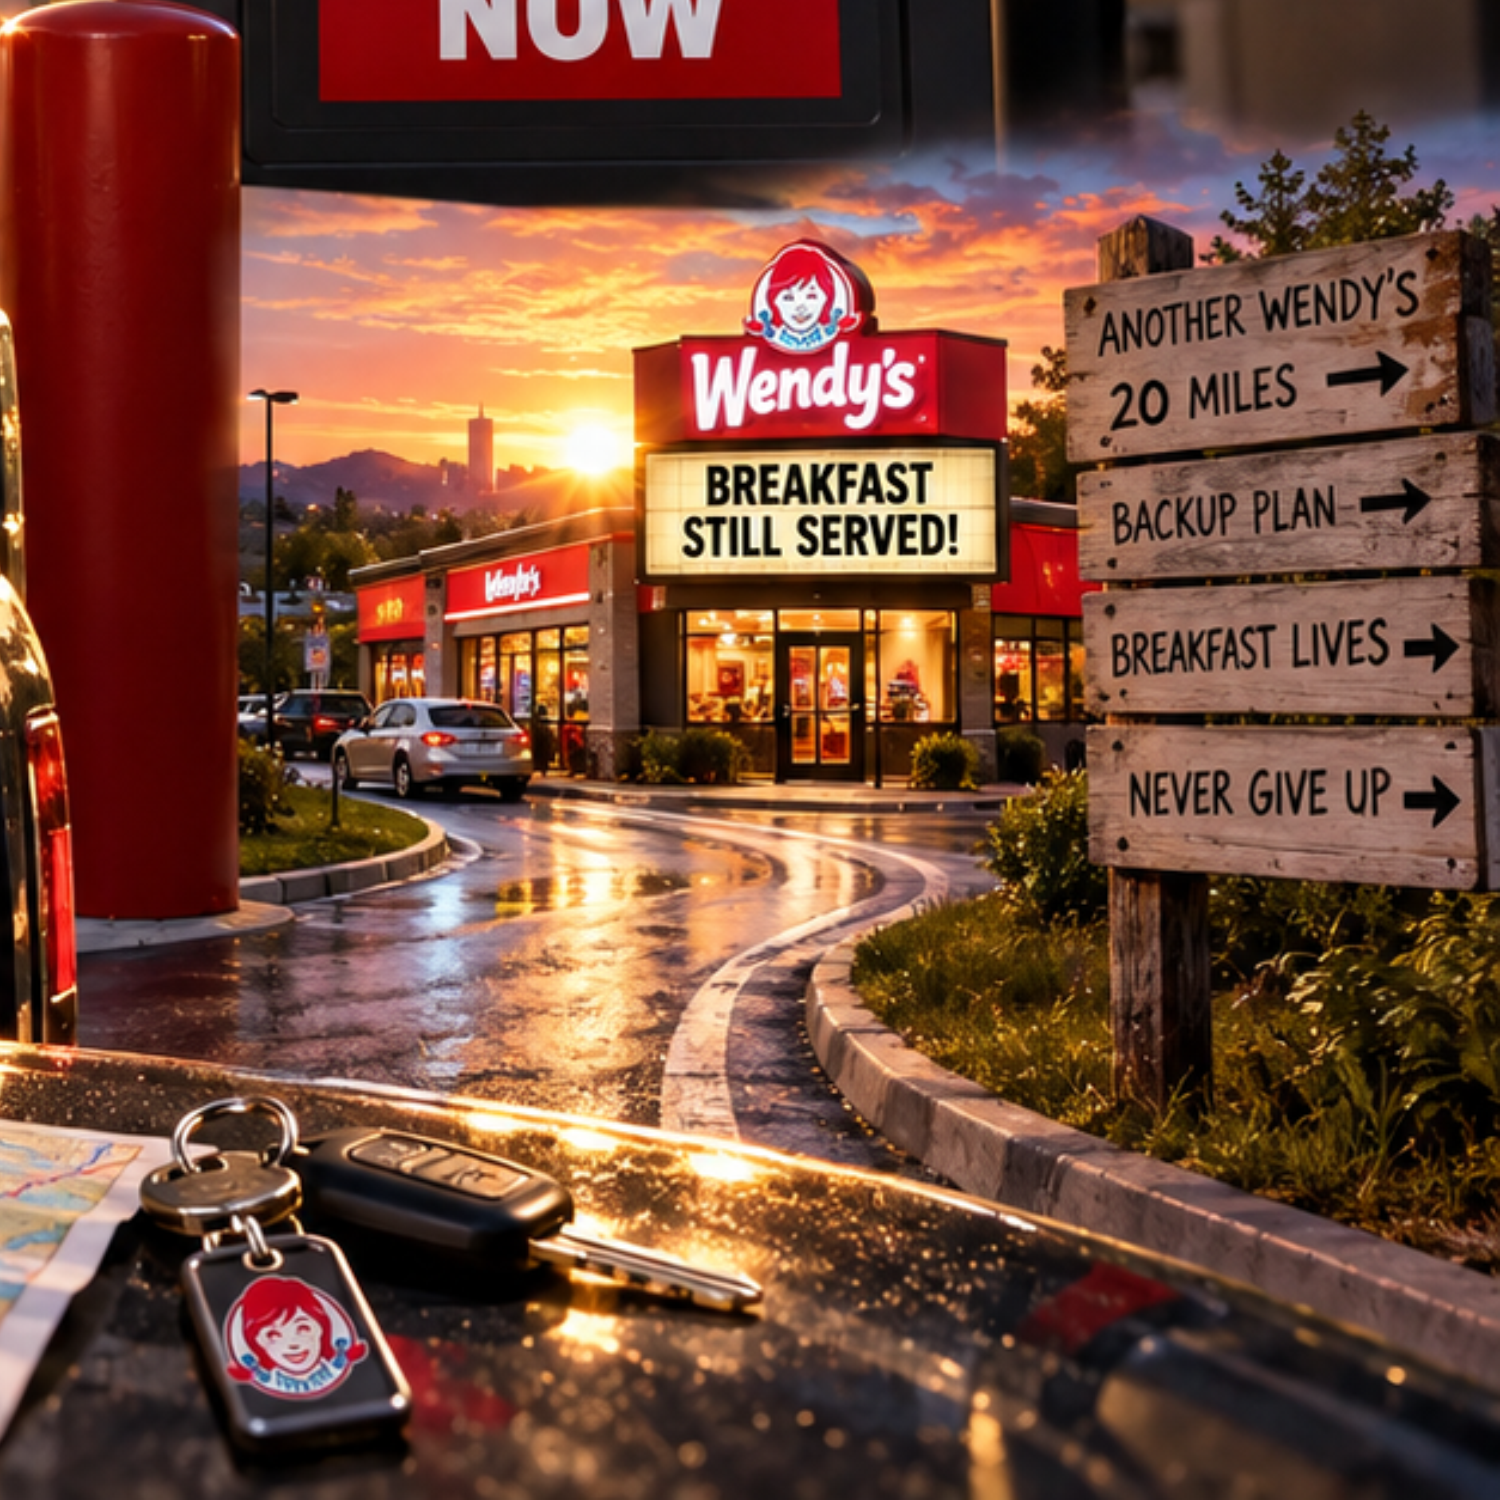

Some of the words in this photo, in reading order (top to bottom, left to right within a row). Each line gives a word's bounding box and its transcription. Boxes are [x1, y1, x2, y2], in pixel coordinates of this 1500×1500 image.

[1098, 296, 1246, 358] ANOTHER
[1258, 267, 1420, 335] WENDY'S
[691, 341, 916, 431] Wendy's
[1110, 379, 1169, 431] 20
[1188, 363, 1298, 419] MILES
[706, 461, 934, 506] BREAKFAST
[682, 516, 783, 558] STILL
[796, 513, 959, 557] SERVED!
[1112, 491, 1238, 546] BACKUP
[1252, 484, 1336, 535] PLAN
[1111, 623, 1278, 678] BREAKFAST
[1292, 617, 1390, 669] LIVES
[1129, 768, 1234, 818] NEVER
[1248, 768, 1328, 817] GIVE
[1345, 766, 1392, 817] UP
